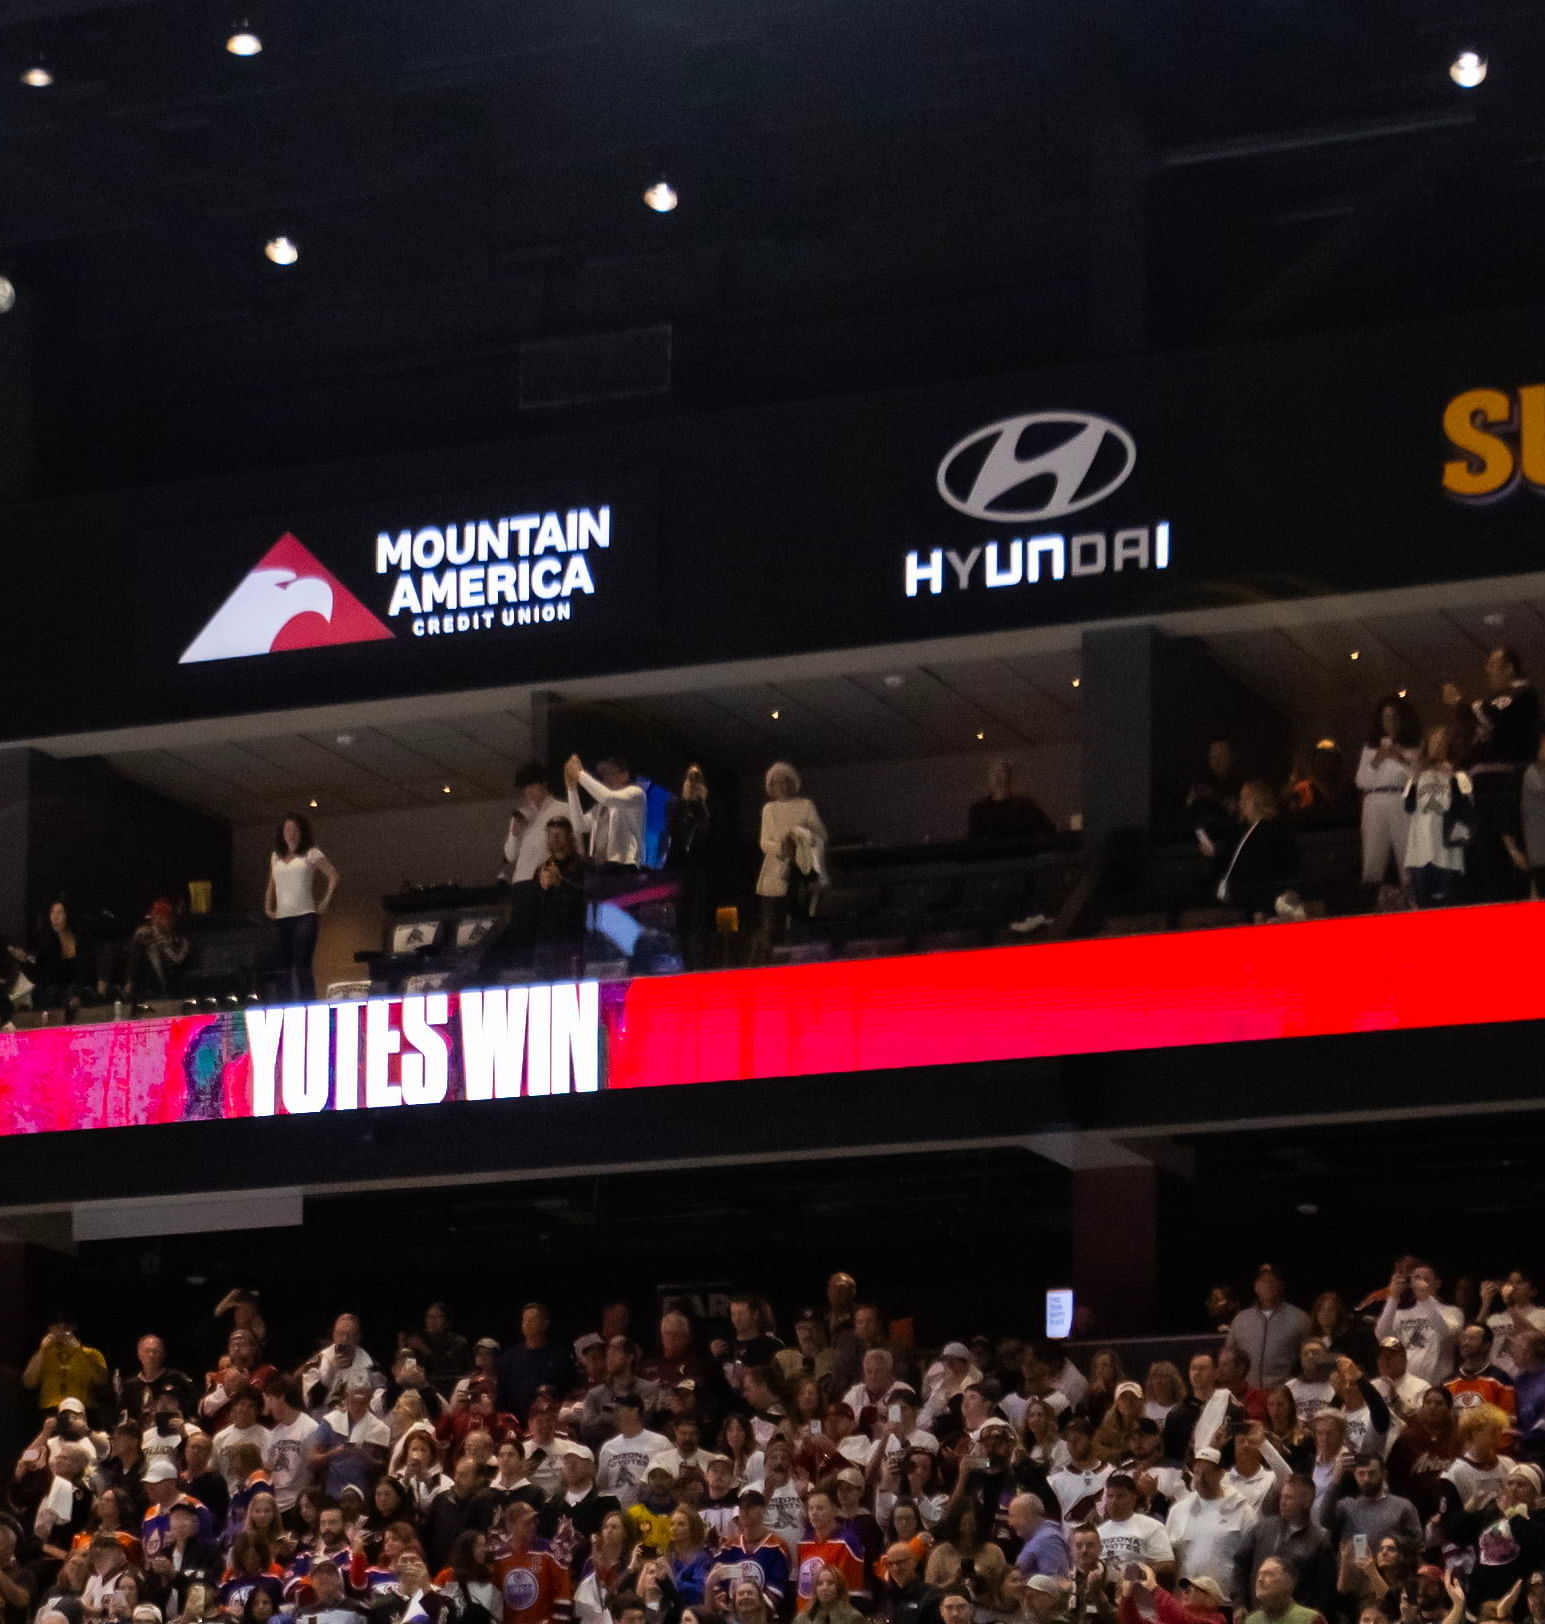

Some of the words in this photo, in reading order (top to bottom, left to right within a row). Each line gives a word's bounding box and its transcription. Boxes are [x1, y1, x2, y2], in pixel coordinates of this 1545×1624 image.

[376, 505, 610, 574] MOUNTAIN
[905, 520, 1170, 597] HYUNDAI
[388, 553, 594, 617] AMERICA
[412, 610, 494, 636] CREDIT
[502, 602, 570, 627] UNION
[459, 981, 599, 1101] WIN
